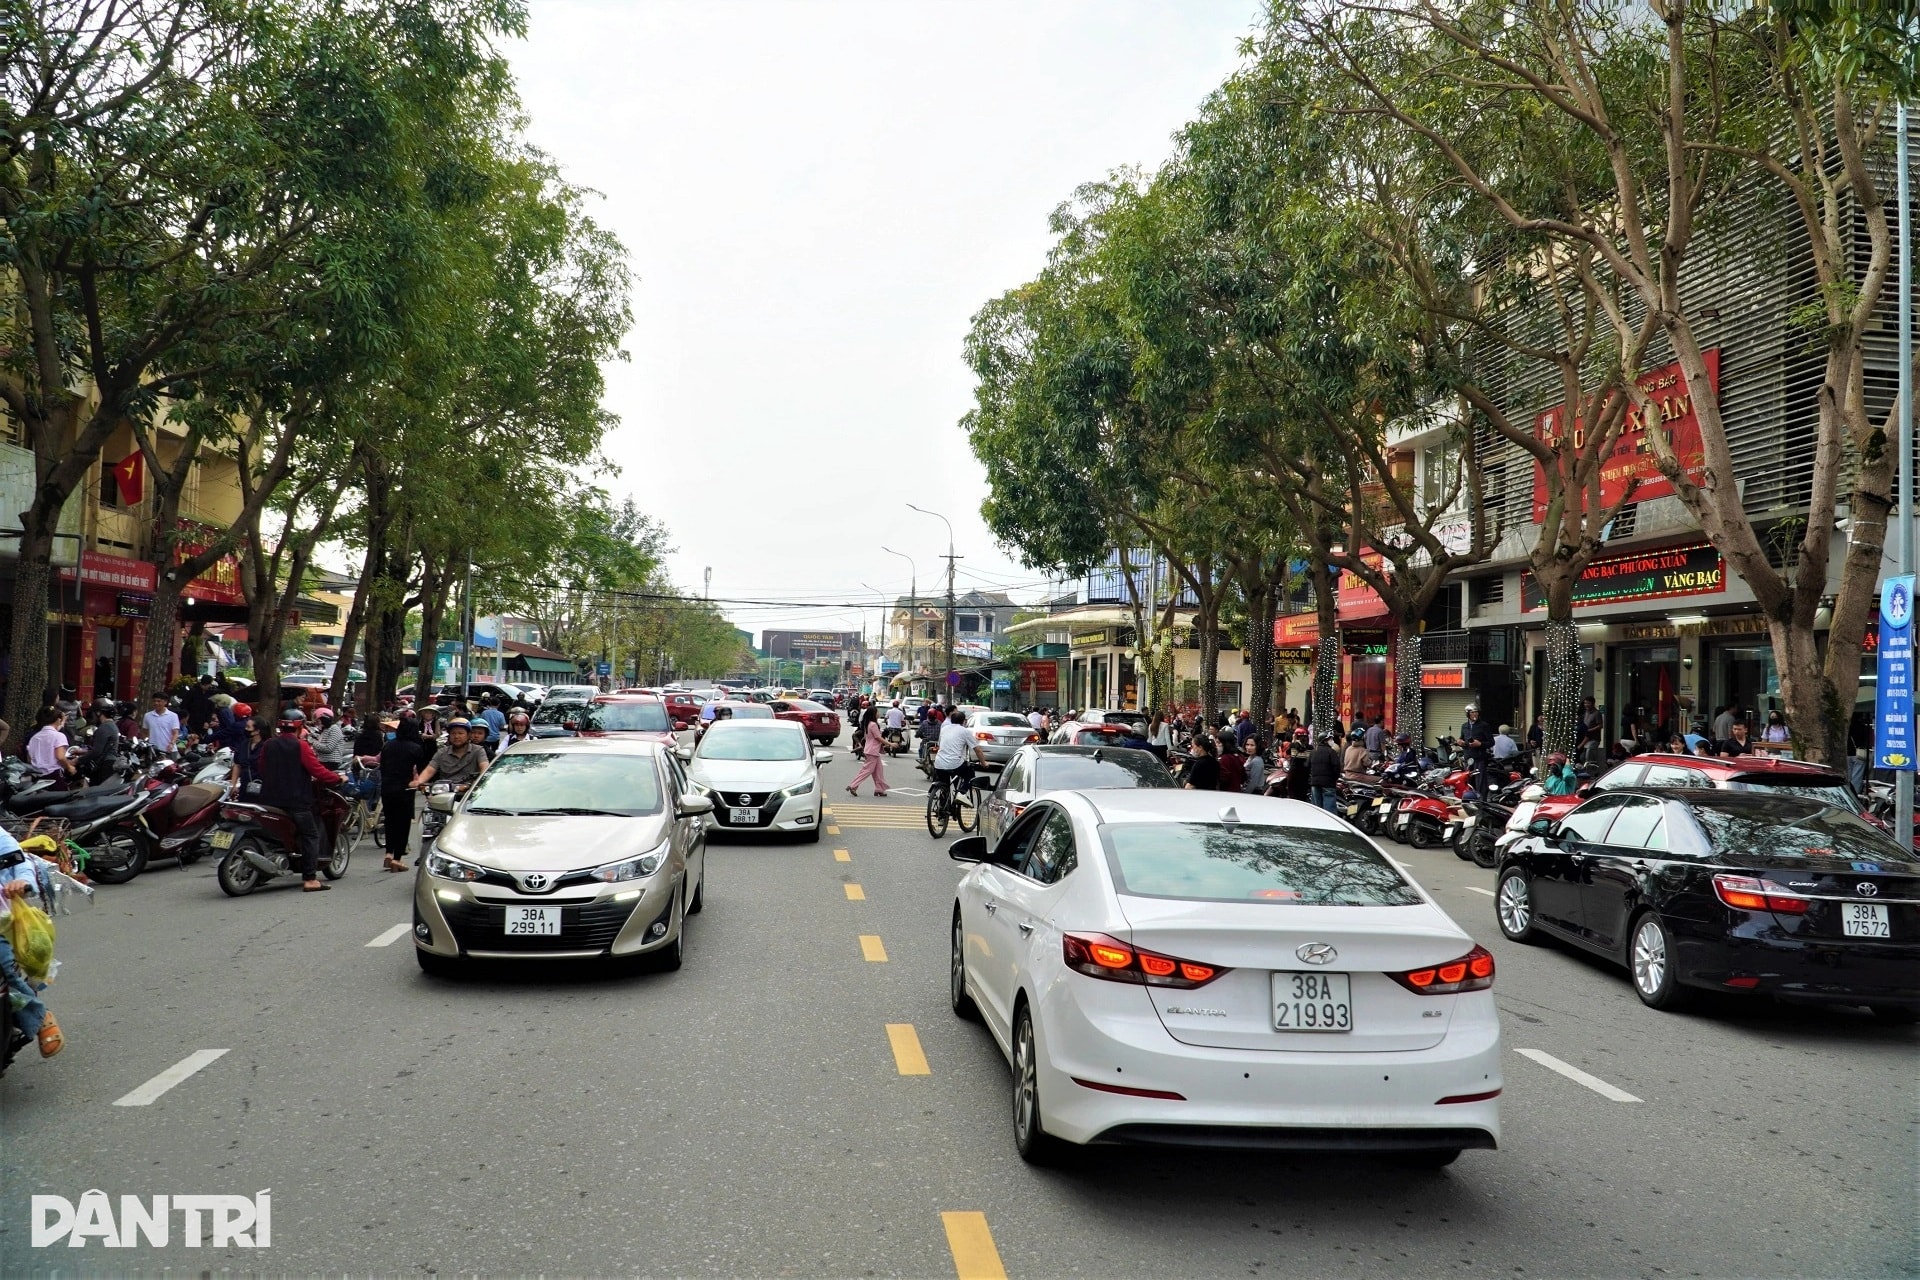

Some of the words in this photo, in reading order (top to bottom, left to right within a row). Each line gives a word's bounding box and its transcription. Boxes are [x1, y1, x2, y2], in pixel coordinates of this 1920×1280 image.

[1658, 374, 1677, 390] BẠC
[1628, 394, 1690, 432] XÂN
[1601, 564, 1618, 579] BẠC
[1664, 570, 1695, 589] VÀNG
[1697, 569, 1721, 587] BẠC
[1279, 650, 1300, 660] NGỌC
[521, 908, 545, 921] 38A
[1853, 904, 1878, 920] 38A
[511, 921, 553, 934] 299.11
[1846, 920, 1889, 936] 175.72
[1291, 975, 1332, 1000] 38A
[1166, 1006, 1227, 1018] ELANTRA
[1276, 1002, 1349, 1028] 219.93
